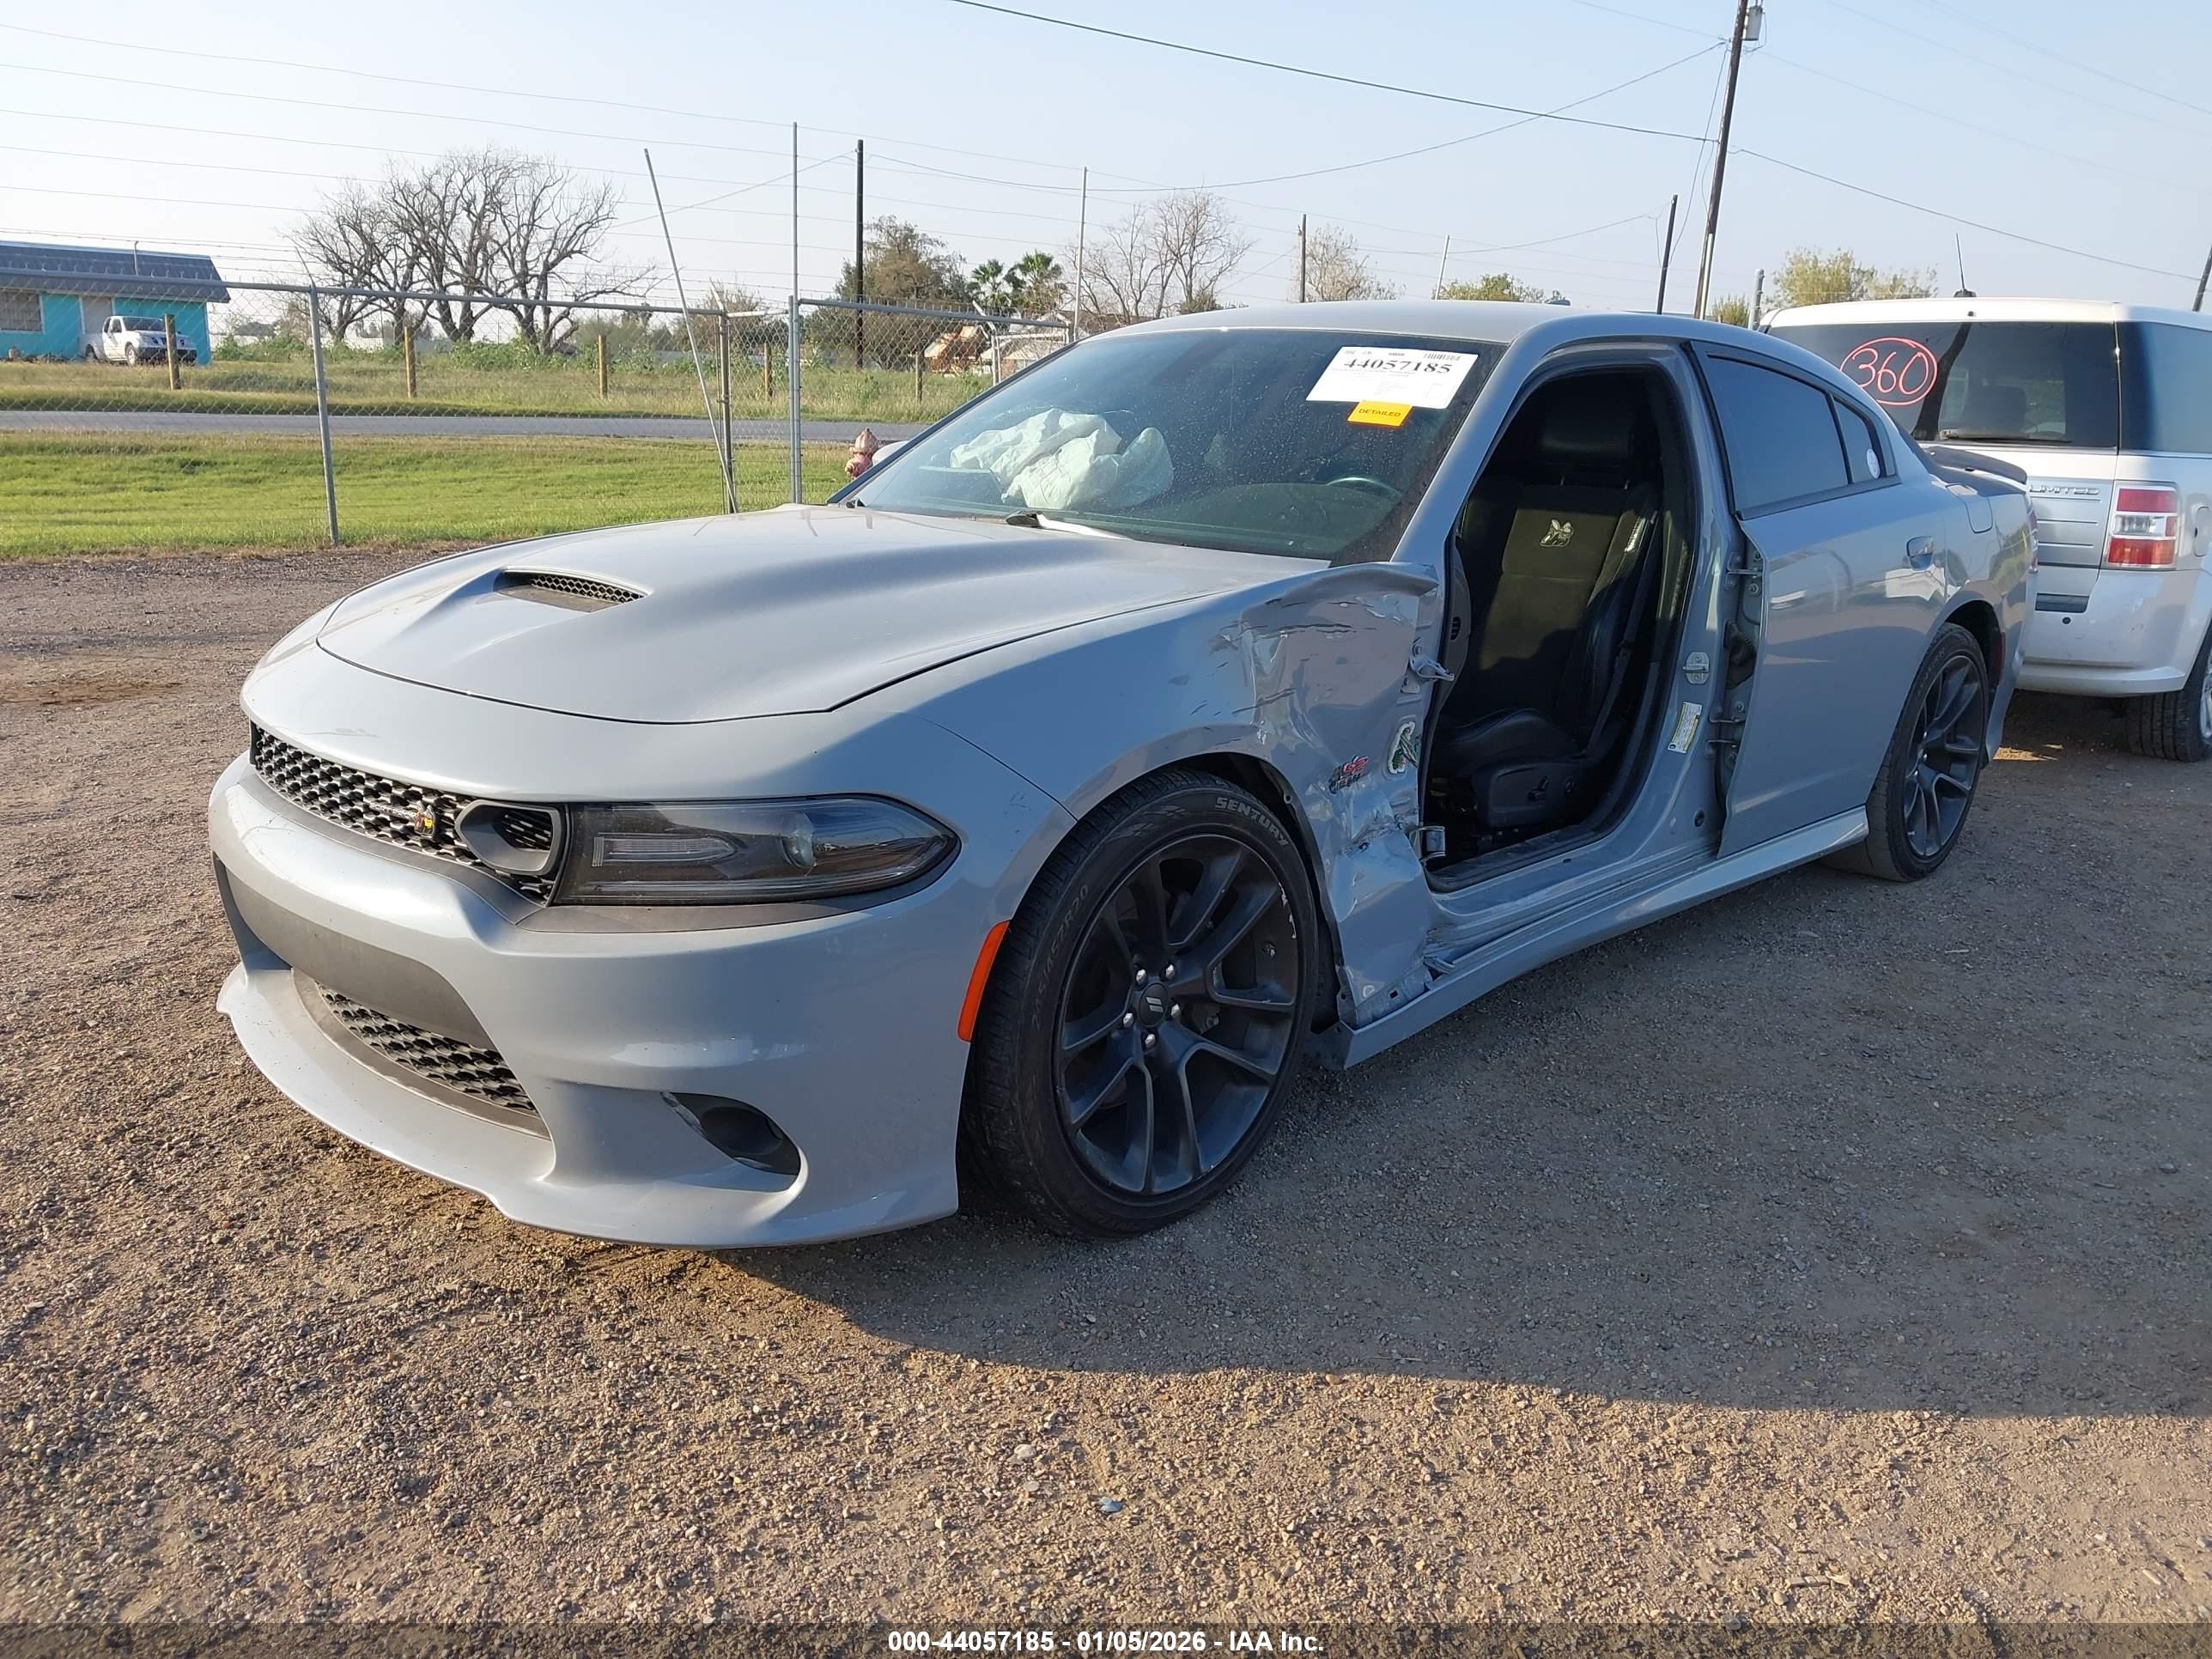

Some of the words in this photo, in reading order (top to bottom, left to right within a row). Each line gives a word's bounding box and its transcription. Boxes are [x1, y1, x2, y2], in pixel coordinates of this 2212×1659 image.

[1344, 358, 1453, 374] 44057185
[1852, 348, 1929, 394] 360
[1358, 408, 1401, 417] DETAILED
[2029, 484, 2100, 495] LIMITED
[1214, 795, 1289, 847] SENTURY
